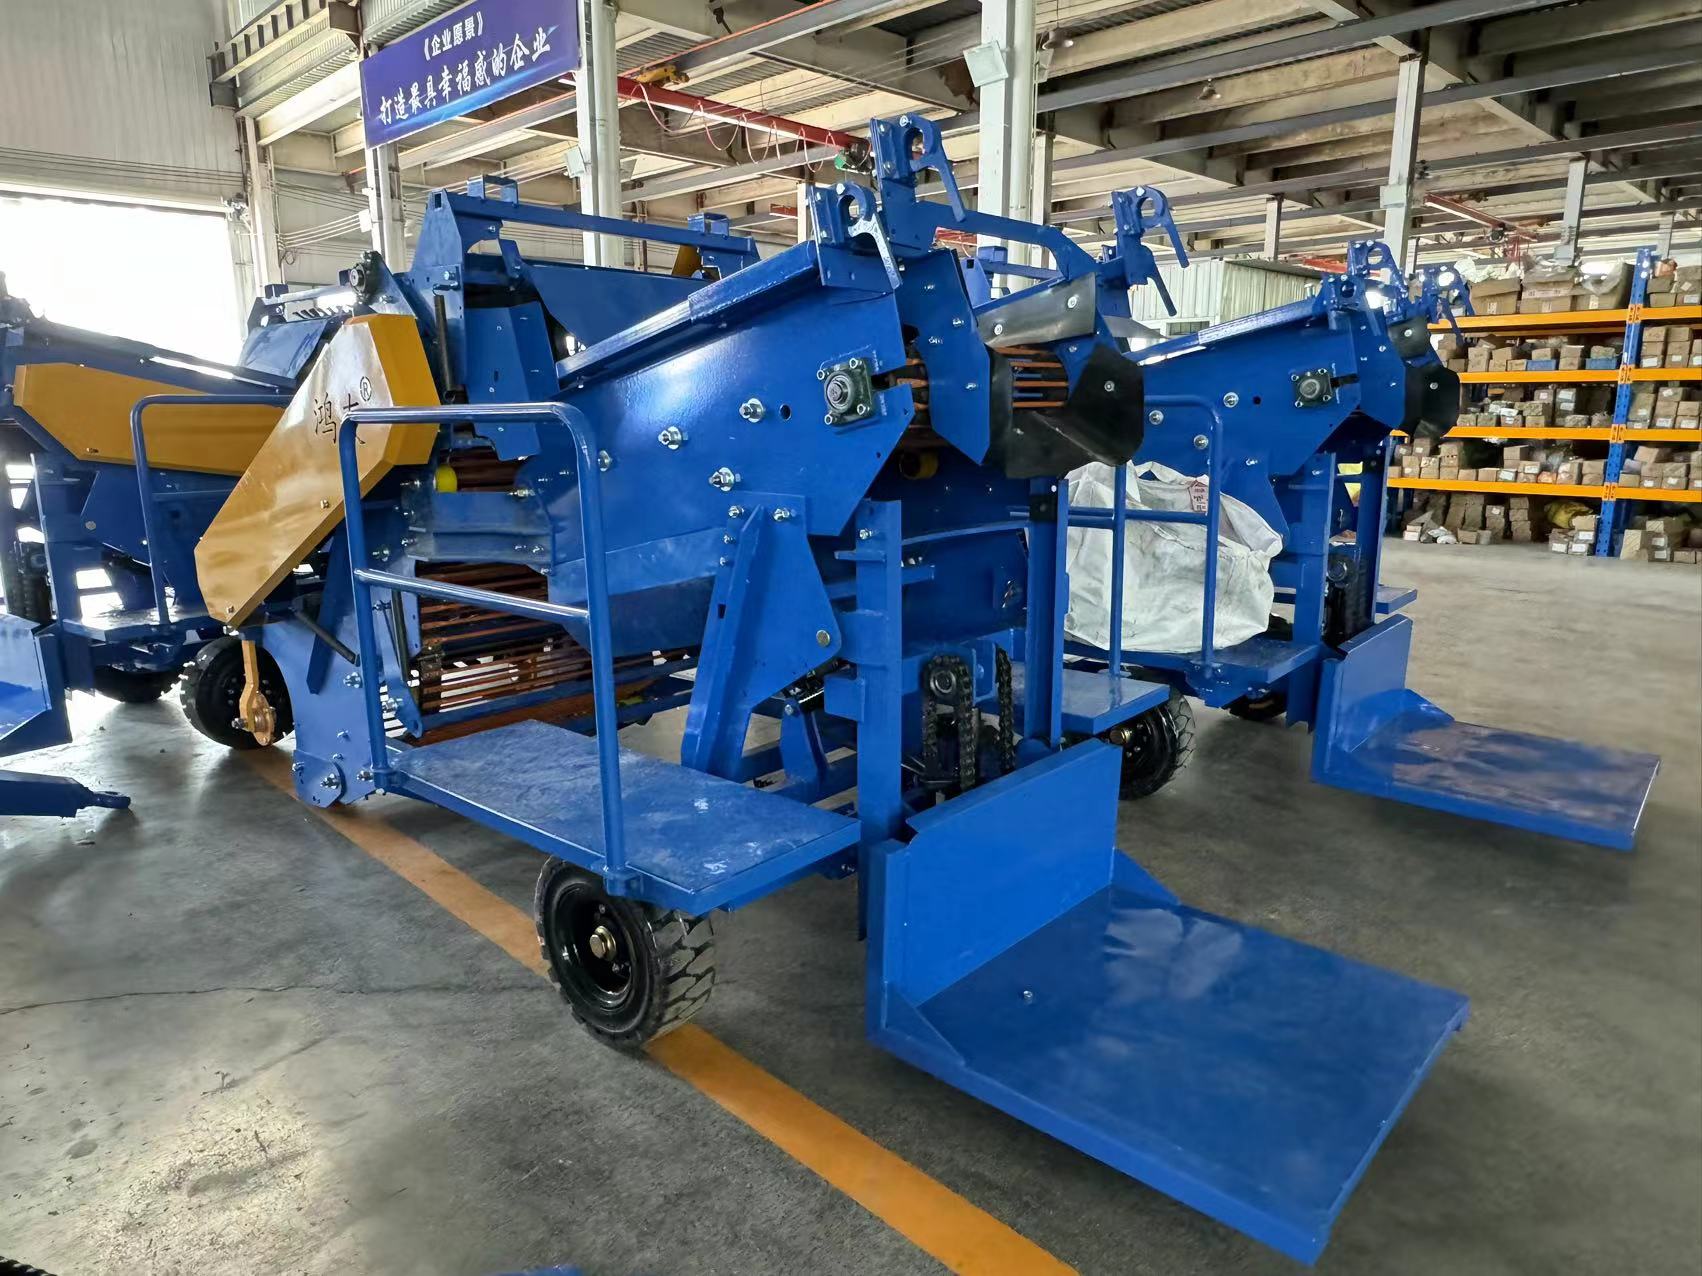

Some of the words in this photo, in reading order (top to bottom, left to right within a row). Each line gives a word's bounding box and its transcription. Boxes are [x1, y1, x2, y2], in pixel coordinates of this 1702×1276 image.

[379, 26, 551, 126] 打造最具幸福感的企业
